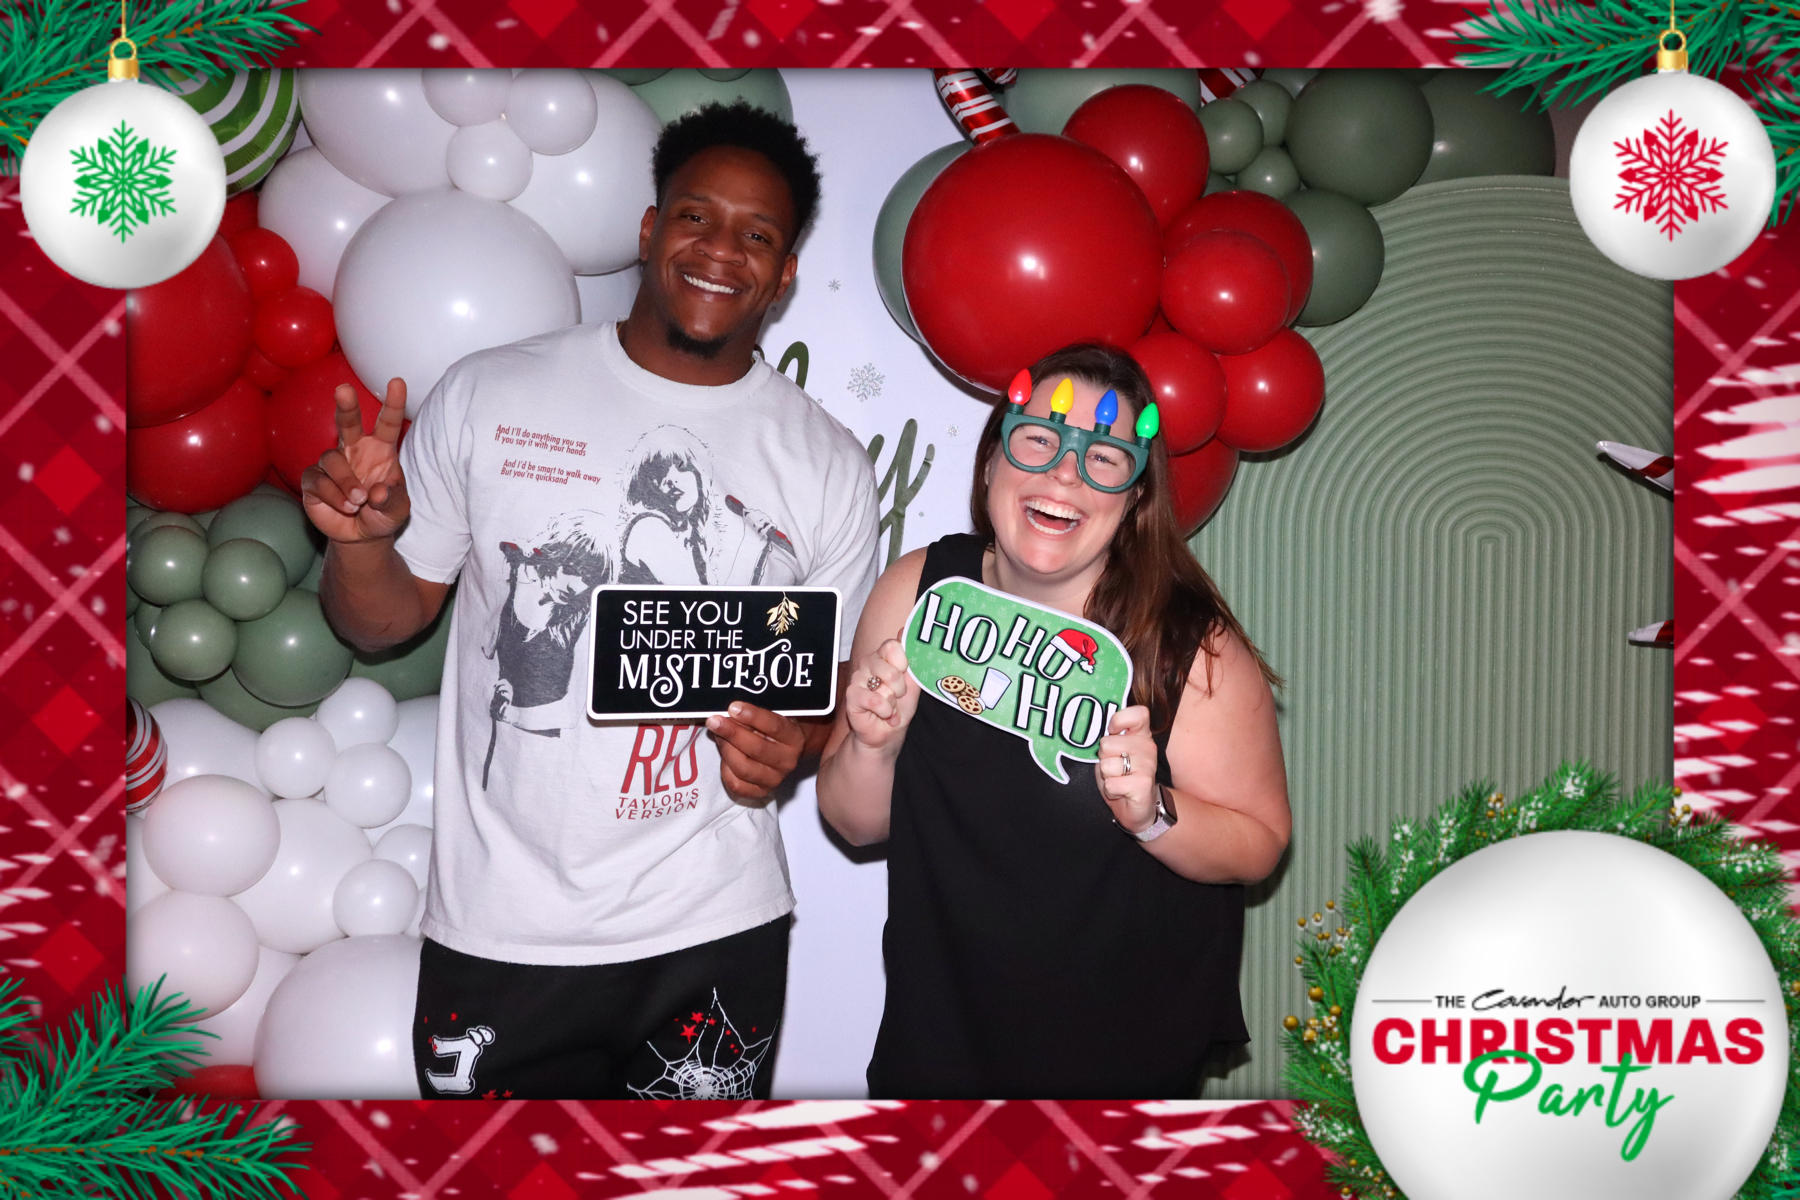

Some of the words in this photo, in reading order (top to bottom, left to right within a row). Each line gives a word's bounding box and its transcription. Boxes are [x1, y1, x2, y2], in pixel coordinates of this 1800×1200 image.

[496, 424, 510, 435] And
[511, 427, 521, 437] I'll
[522, 428, 531, 438] do
[531, 432, 561, 446] anything
[561, 438, 574, 446] you
[576, 440, 587, 451] say
[501, 436, 514, 444] you
[515, 438, 527, 448] say
[528, 438, 533, 447] it
[534, 440, 549, 450] with
[549, 444, 565, 452] your
[566, 444, 586, 456] hands
[500, 466, 512, 476] But
[512, 470, 534, 479] you're
[535, 472, 568, 485] quicksand
[503, 459, 517, 468] And
[517, 460, 527, 470] I'd
[527, 461, 536, 471] be
[537, 465, 557, 475] smart
[557, 467, 564, 476] to
[565, 469, 581, 479] walk
[583, 473, 601, 485] away
[622, 600, 670, 625] SEE
[680, 600, 743, 626] YOU
[619, 629, 696, 649] UNDER
[703, 629, 743, 649] THE
[917, 590, 999, 666] HO
[1000, 614, 1075, 681] HO
[618, 638, 815, 708] MISTLETOE
[615, 799, 698, 820] VERSION
[618, 788, 699, 809] TAYLOR'S
